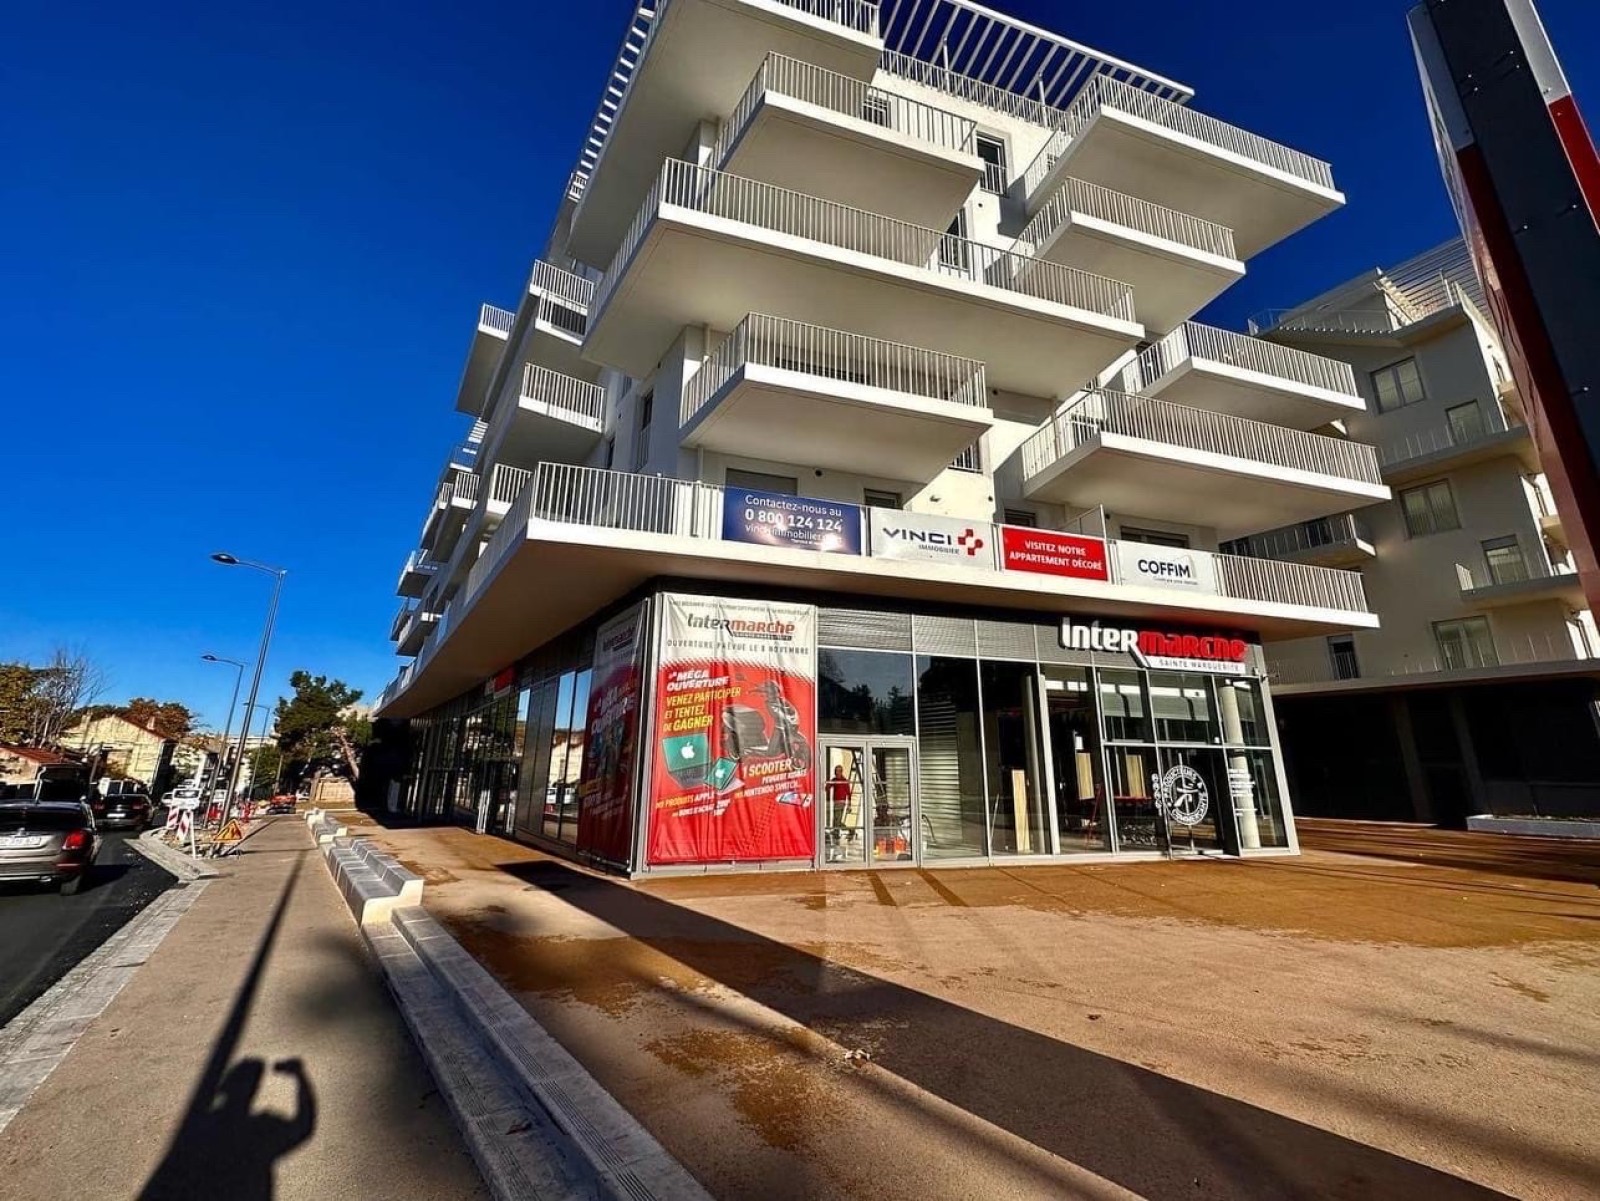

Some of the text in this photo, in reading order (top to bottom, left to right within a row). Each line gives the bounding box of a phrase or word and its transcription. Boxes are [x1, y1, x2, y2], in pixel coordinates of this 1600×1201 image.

[745, 494, 827, 515] Contactez-nous
[745, 508, 754, 521] 0
[758, 510, 784, 525] 800
[787, 514, 814, 529] 124
[882, 527, 952, 545] VINCI
[918, 544, 960, 555] IMMOBILIER
[1025, 540, 1087, 556] VISITEZ NOTRE
[1009, 551, 1103, 571] APPARTEMENT DÉCORÉ
[1137, 559, 1191, 578] COFFIM
[667, 639, 713, 649] OUVERTURE
[749, 644, 757, 652] LE
[768, 646, 809, 655] NOVEMBRE
[1159, 658, 1188, 668] SAINTE
[666, 676, 729, 692] OUVERTURE
[666, 686, 741, 707] VENEZ PARTICIPER
[675, 705, 705, 719] TENTEZ
[672, 715, 713, 731] GAGNER
[748, 758, 792, 777] SCOOTER
